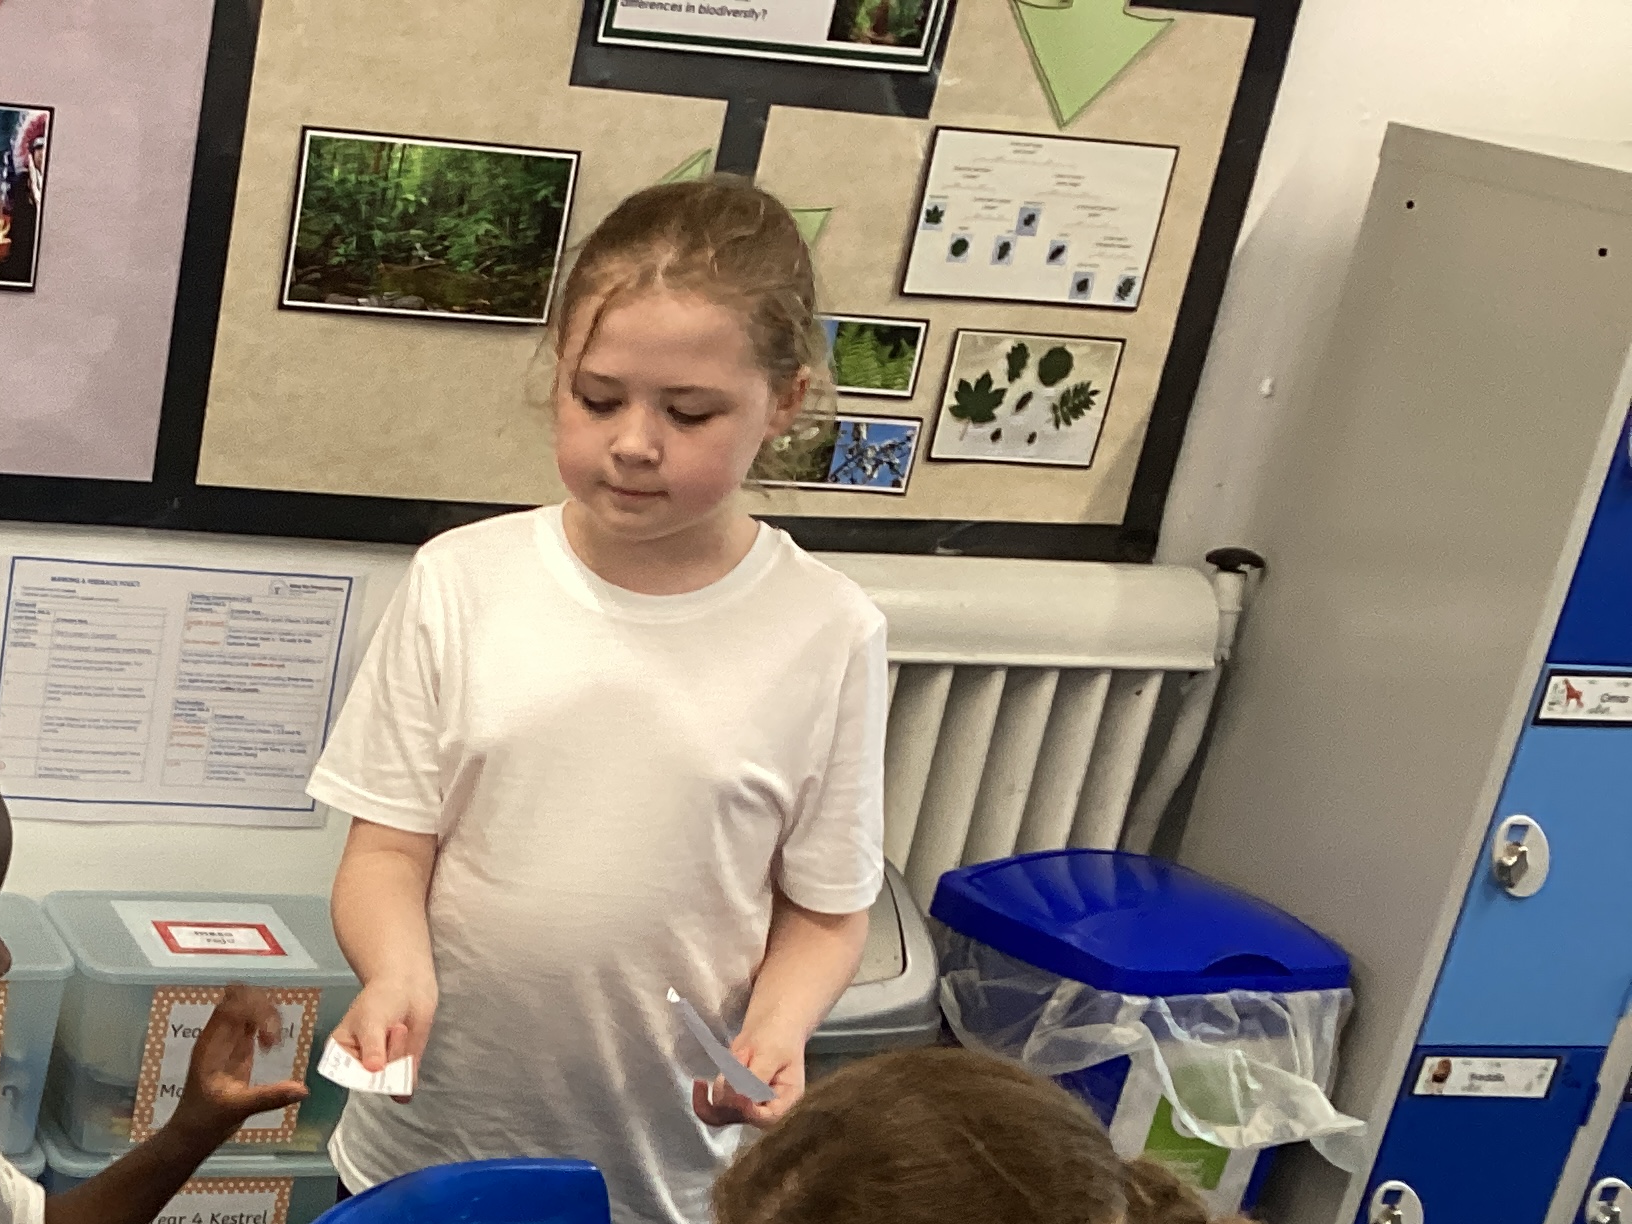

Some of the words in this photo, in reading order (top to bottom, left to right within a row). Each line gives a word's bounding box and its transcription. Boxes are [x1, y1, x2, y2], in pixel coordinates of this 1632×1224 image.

[685, 4, 695, 13] in
[698, 4, 768, 21] biodiversity?
[171, 1023, 202, 1039] Yea
